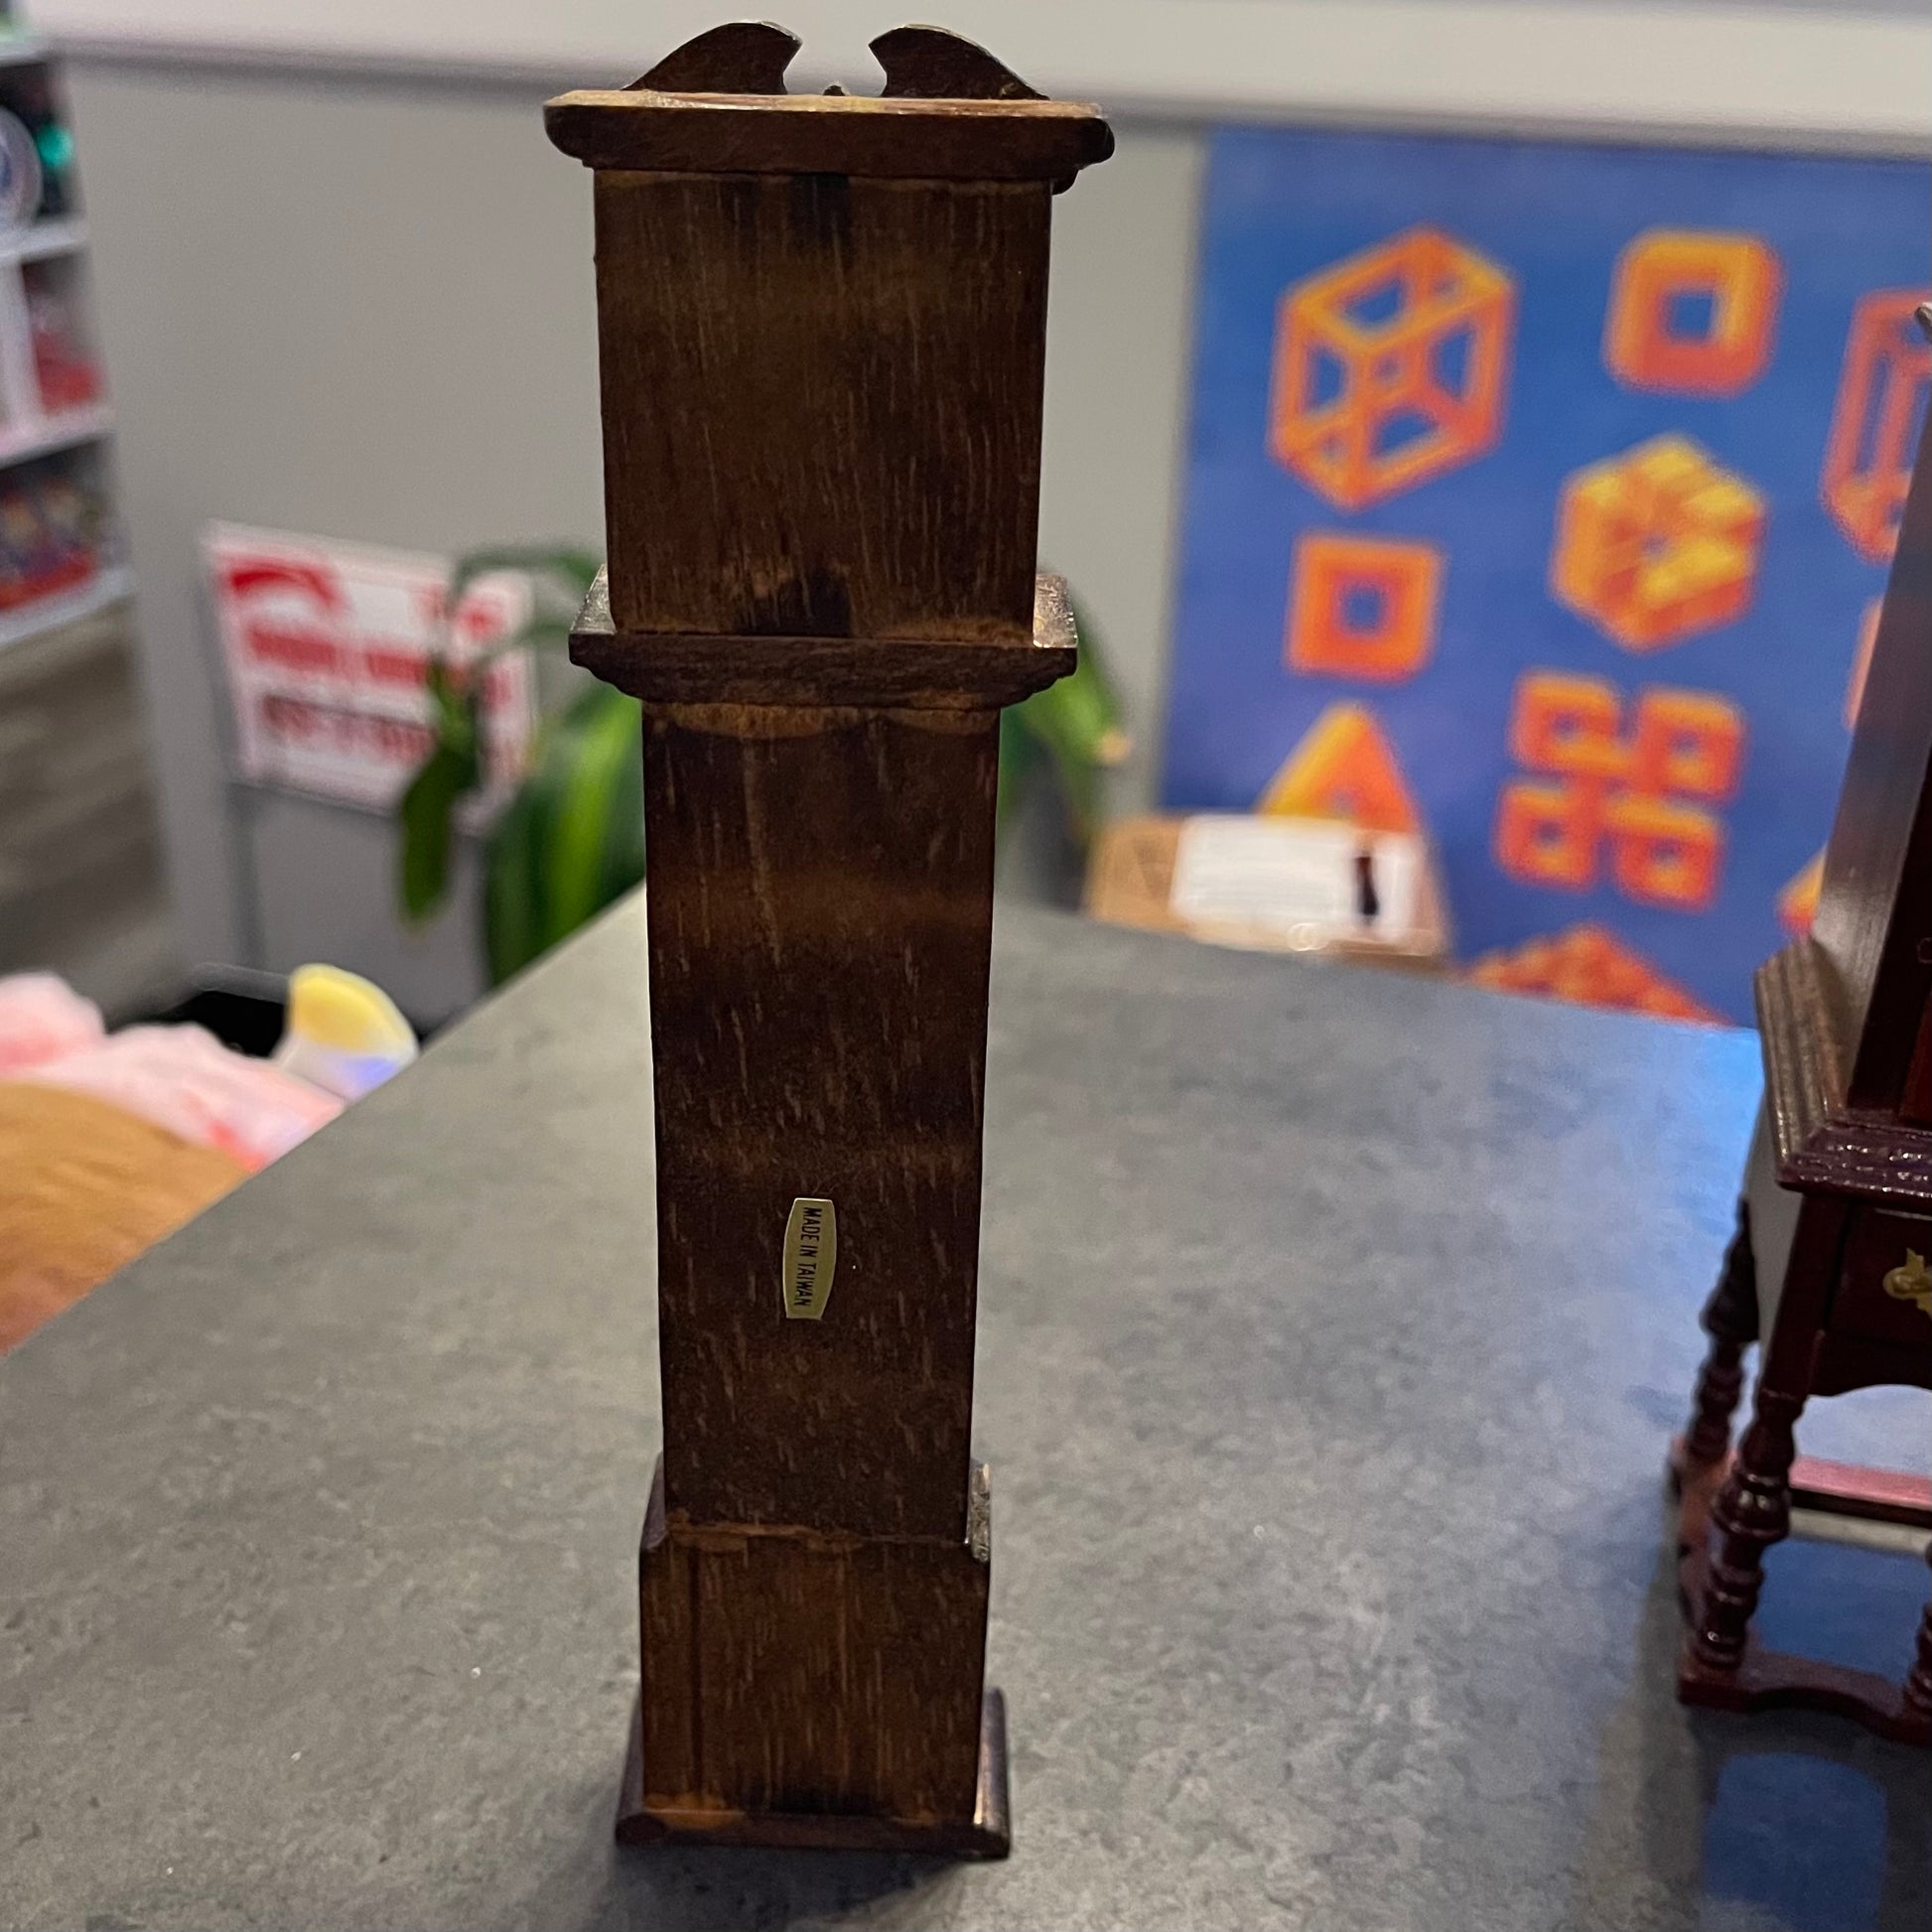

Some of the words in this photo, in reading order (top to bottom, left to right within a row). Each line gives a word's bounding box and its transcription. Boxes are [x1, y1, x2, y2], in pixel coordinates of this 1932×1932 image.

[800, 1206, 823, 1242] MADE
[799, 1244, 819, 1259] IN
[793, 1263, 817, 1307] TAIWAN
